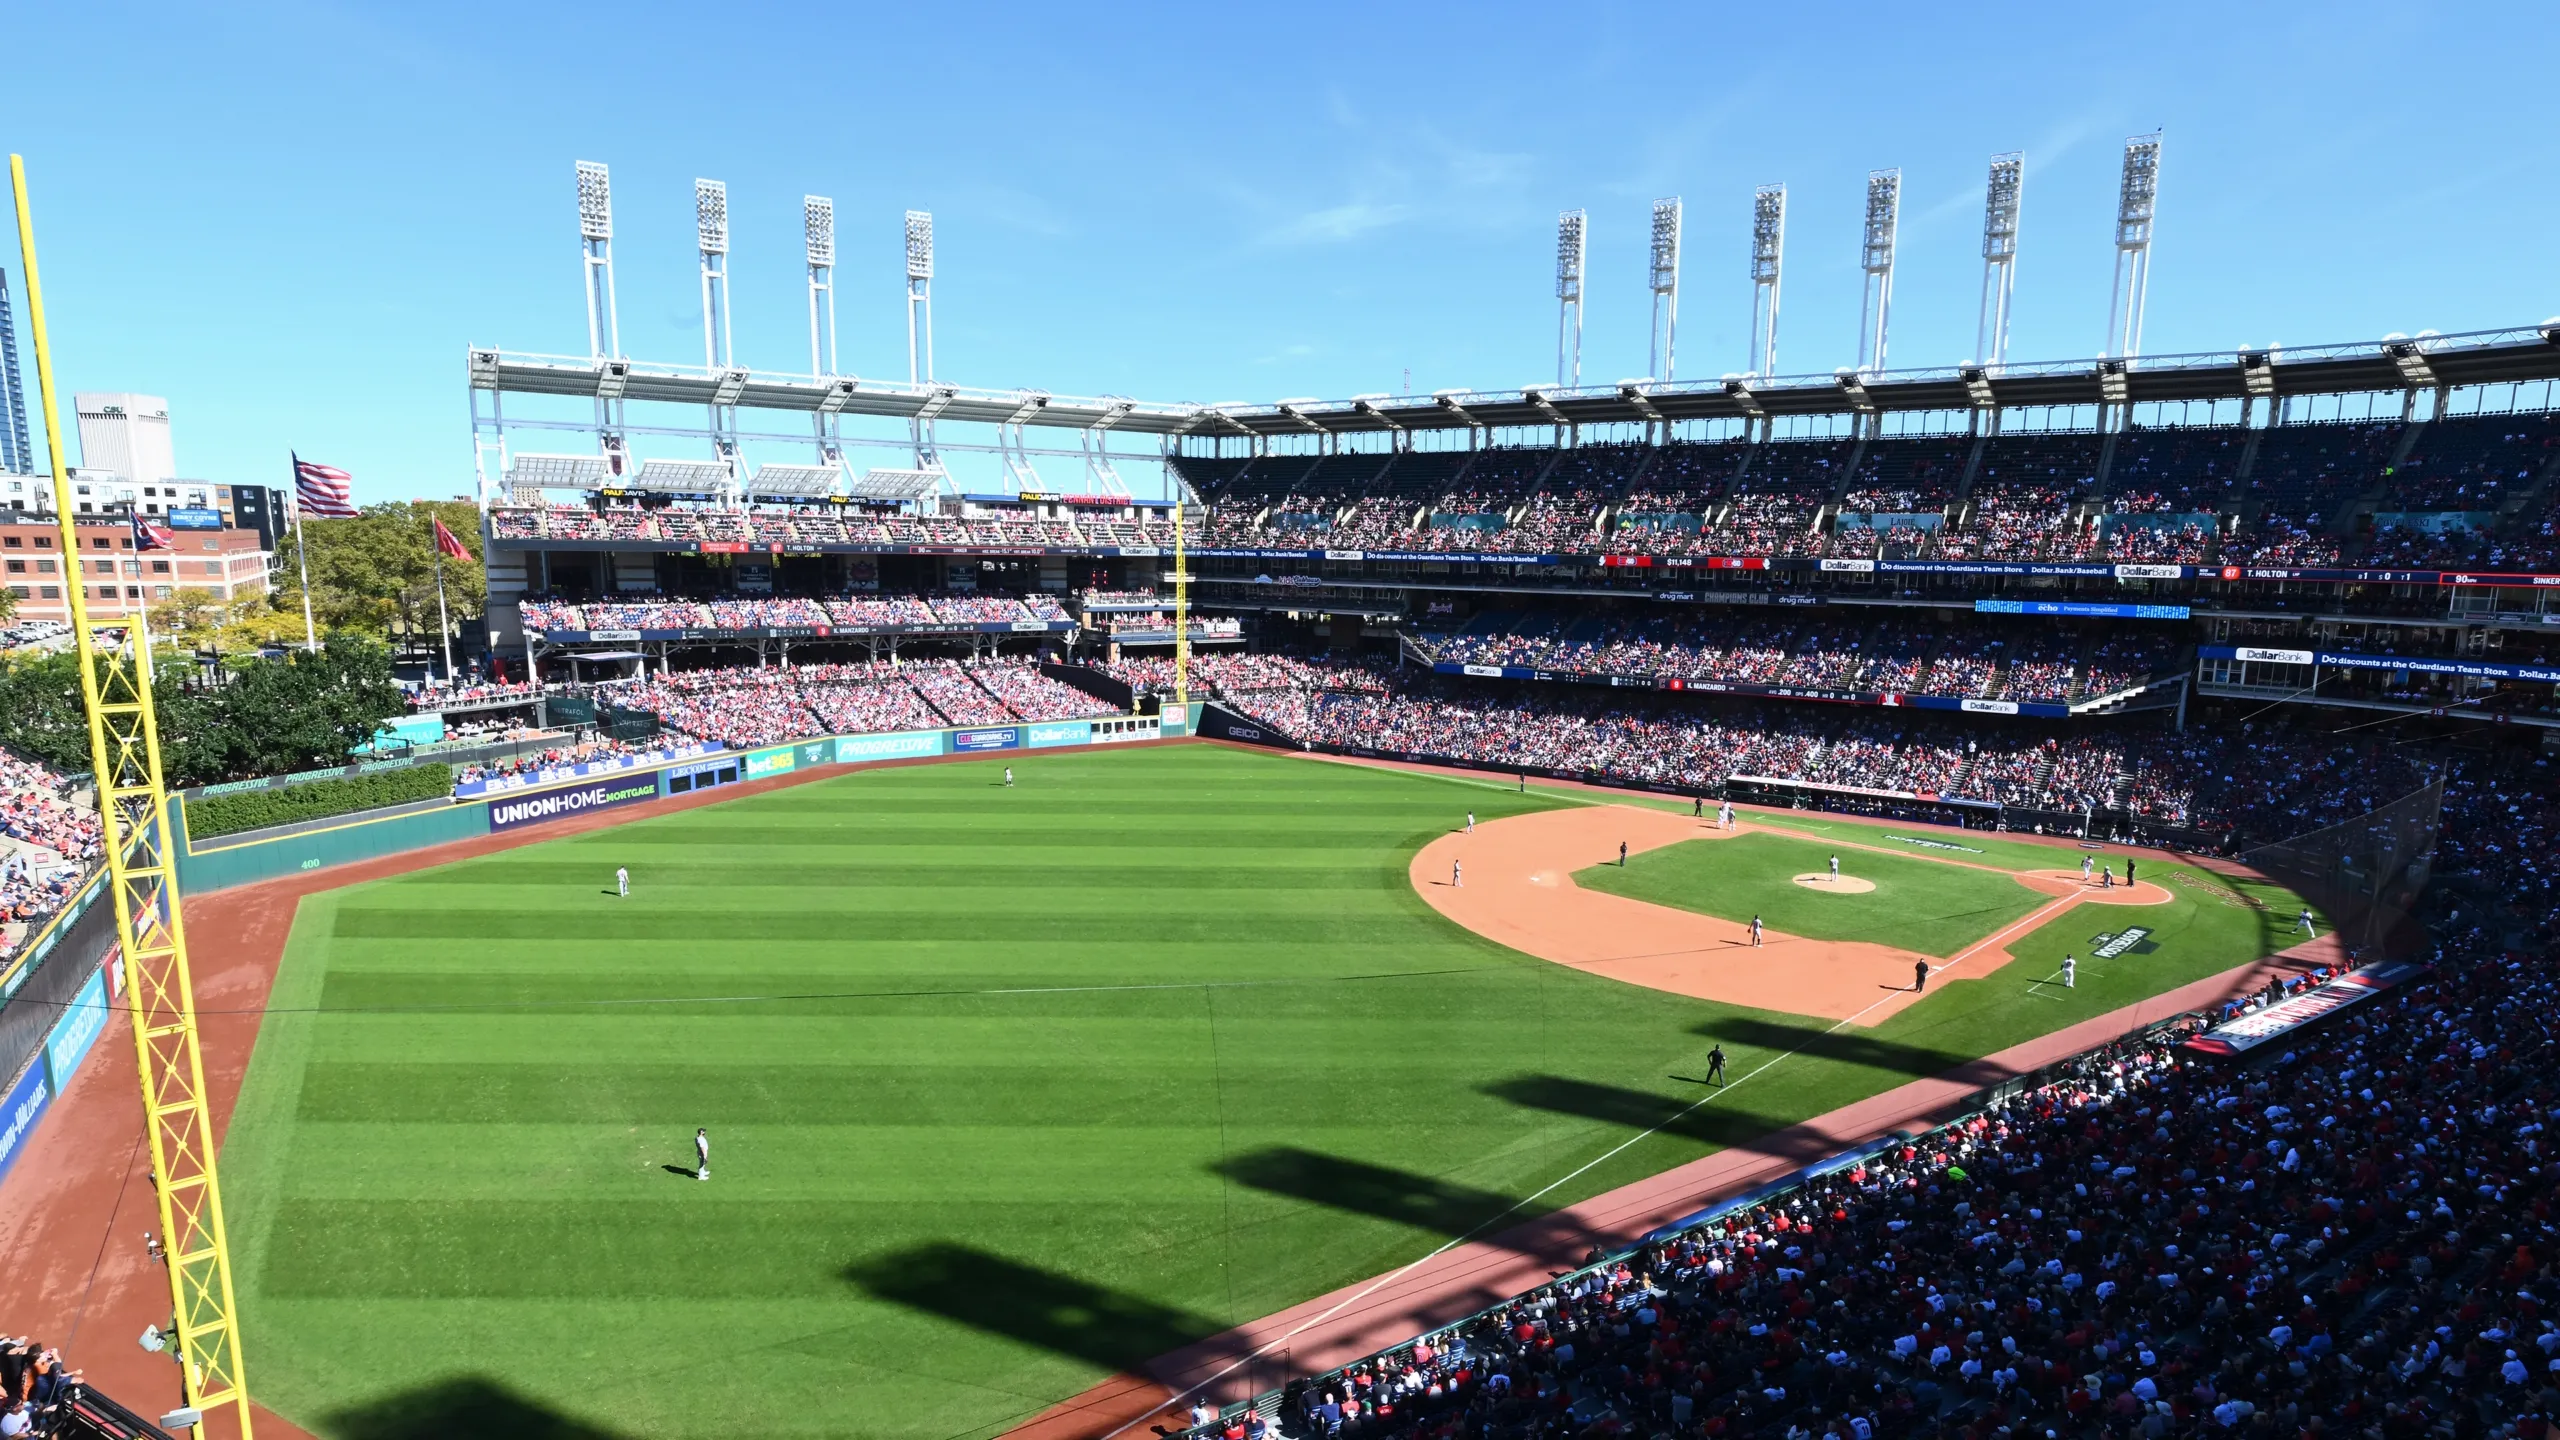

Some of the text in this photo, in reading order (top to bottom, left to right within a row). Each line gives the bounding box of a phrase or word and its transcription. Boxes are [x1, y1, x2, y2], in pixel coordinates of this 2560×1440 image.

[103, 406, 124, 414] CSU
[1890, 518, 1915, 526] LAJOIE
[792, 544, 814, 552] HOLTON
[1667, 558, 1692, 566] $11,148
[1880, 562, 1892, 570] Do
[1893, 564, 1926, 572] discounts
[1934, 564, 1945, 572] the
[2031, 566, 2108, 574] Dollar.Bank/Baseball
[2224, 568, 2237, 578] 87
[2247, 570, 2254, 578] T.
[2255, 570, 2288, 578] HOLTON
[2532, 577, 2560, 585] SINKER
[1660, 592, 1676, 600] drug
[1676, 592, 1694, 600] mart
[1704, 592, 1769, 604] CHAMPIONS CLUB
[1778, 596, 1797, 605] drug
[2090, 606, 2118, 614] Simplified
[2322, 654, 2338, 664] Do
[2338, 657, 2381, 667] discounts
[2382, 660, 2392, 668] at
[2392, 660, 2408, 669] the
[2408, 662, 2456, 672] Guardians
[2457, 665, 2482, 674] Team
[2483, 667, 2510, 676] Store.
[1687, 682, 1693, 690] K.
[1694, 683, 1726, 692] MANZARDO
[1778, 688, 1792, 696] .200
[1804, 690, 1818, 698] .400
[2434, 708, 2444, 716] 19
[1120, 731, 1152, 740] CLIFFS
[1228, 726, 1260, 740] GEICO
[839, 737, 935, 756] PROGRESSIVE
[360, 756, 416, 773] PROGRESSIVE
[748, 751, 794, 774] bet365
[284, 766, 346, 784] PROGRESSIVE
[202, 778, 270, 797] PROGRESSIVE
[301, 858, 320, 870] 400
[2094, 928, 2147, 958] POSTSEASON
[53, 985, 103, 1086] PROGRESSIVE
